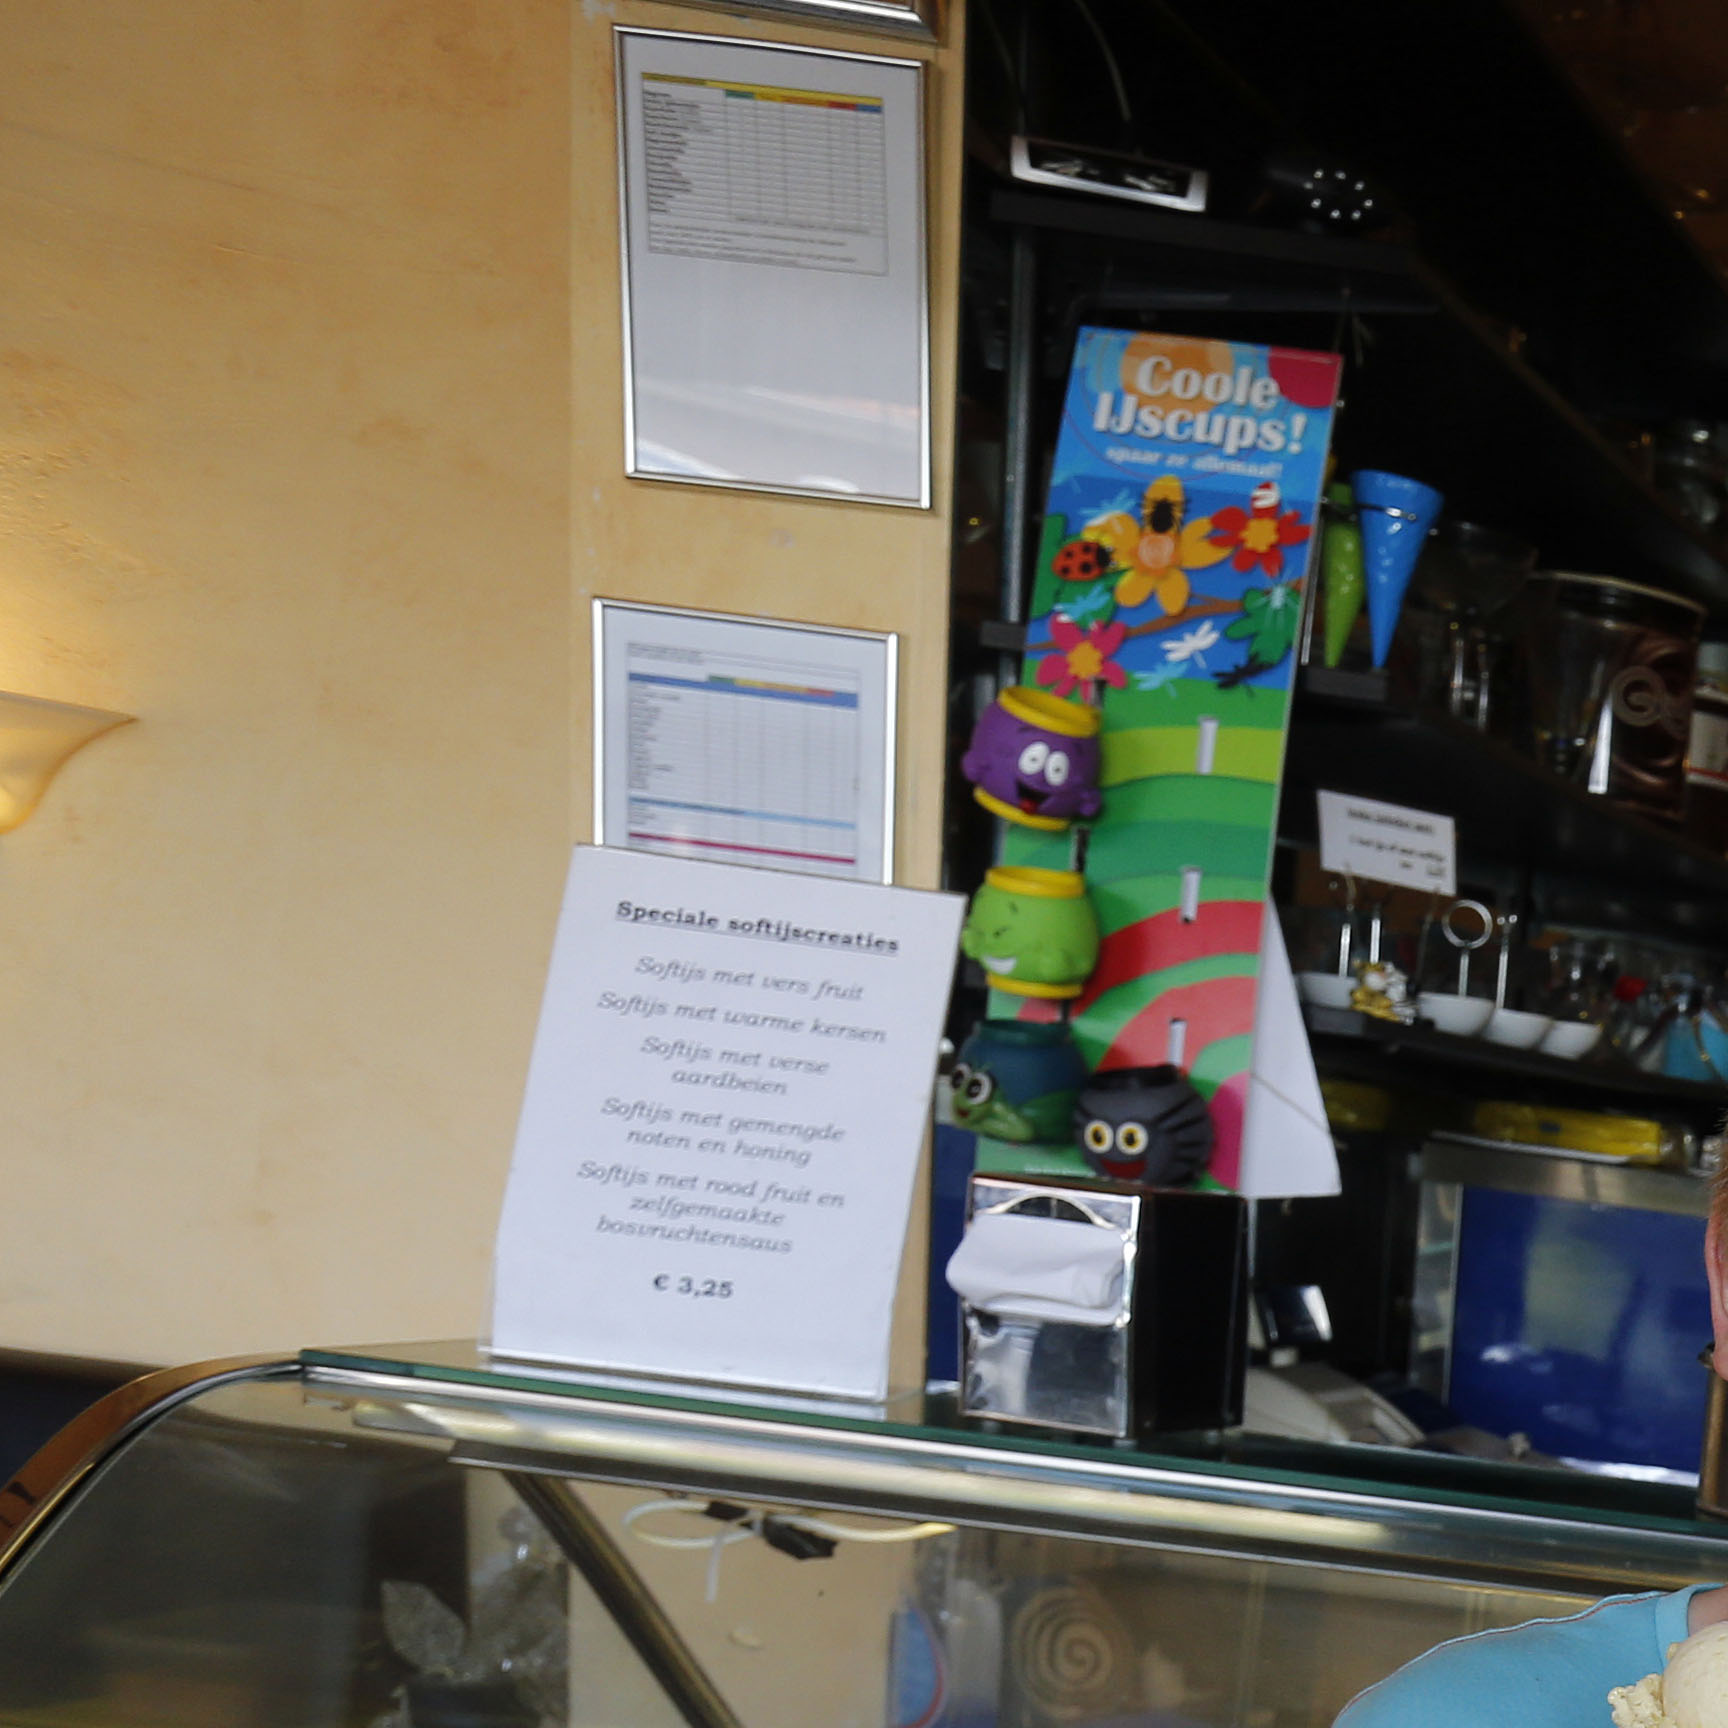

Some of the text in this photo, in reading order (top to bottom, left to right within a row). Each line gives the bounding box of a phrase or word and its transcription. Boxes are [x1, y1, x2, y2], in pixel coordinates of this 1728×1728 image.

[1136, 354, 1280, 409] Coole
[1092, 392, 1308, 456] IJscups!
[616, 900, 900, 954] Speciale softijscreaties
[635, 955, 864, 1001] Softijs met vers fruit
[596, 990, 887, 1043] Softijs met warme kersen
[639, 1036, 830, 1074] Softijs met verse
[672, 1069, 789, 1095] aardbeien
[601, 1097, 846, 1143] Softijs met gemengde
[627, 1129, 812, 1168] noten en honing
[576, 1160, 846, 1208] Softijs met rood fruit en
[595, 1216, 793, 1253] bosvruchtensaus
[630, 1195, 785, 1228] zelfgemaakte
[652, 1272, 735, 1300] € 3,25
